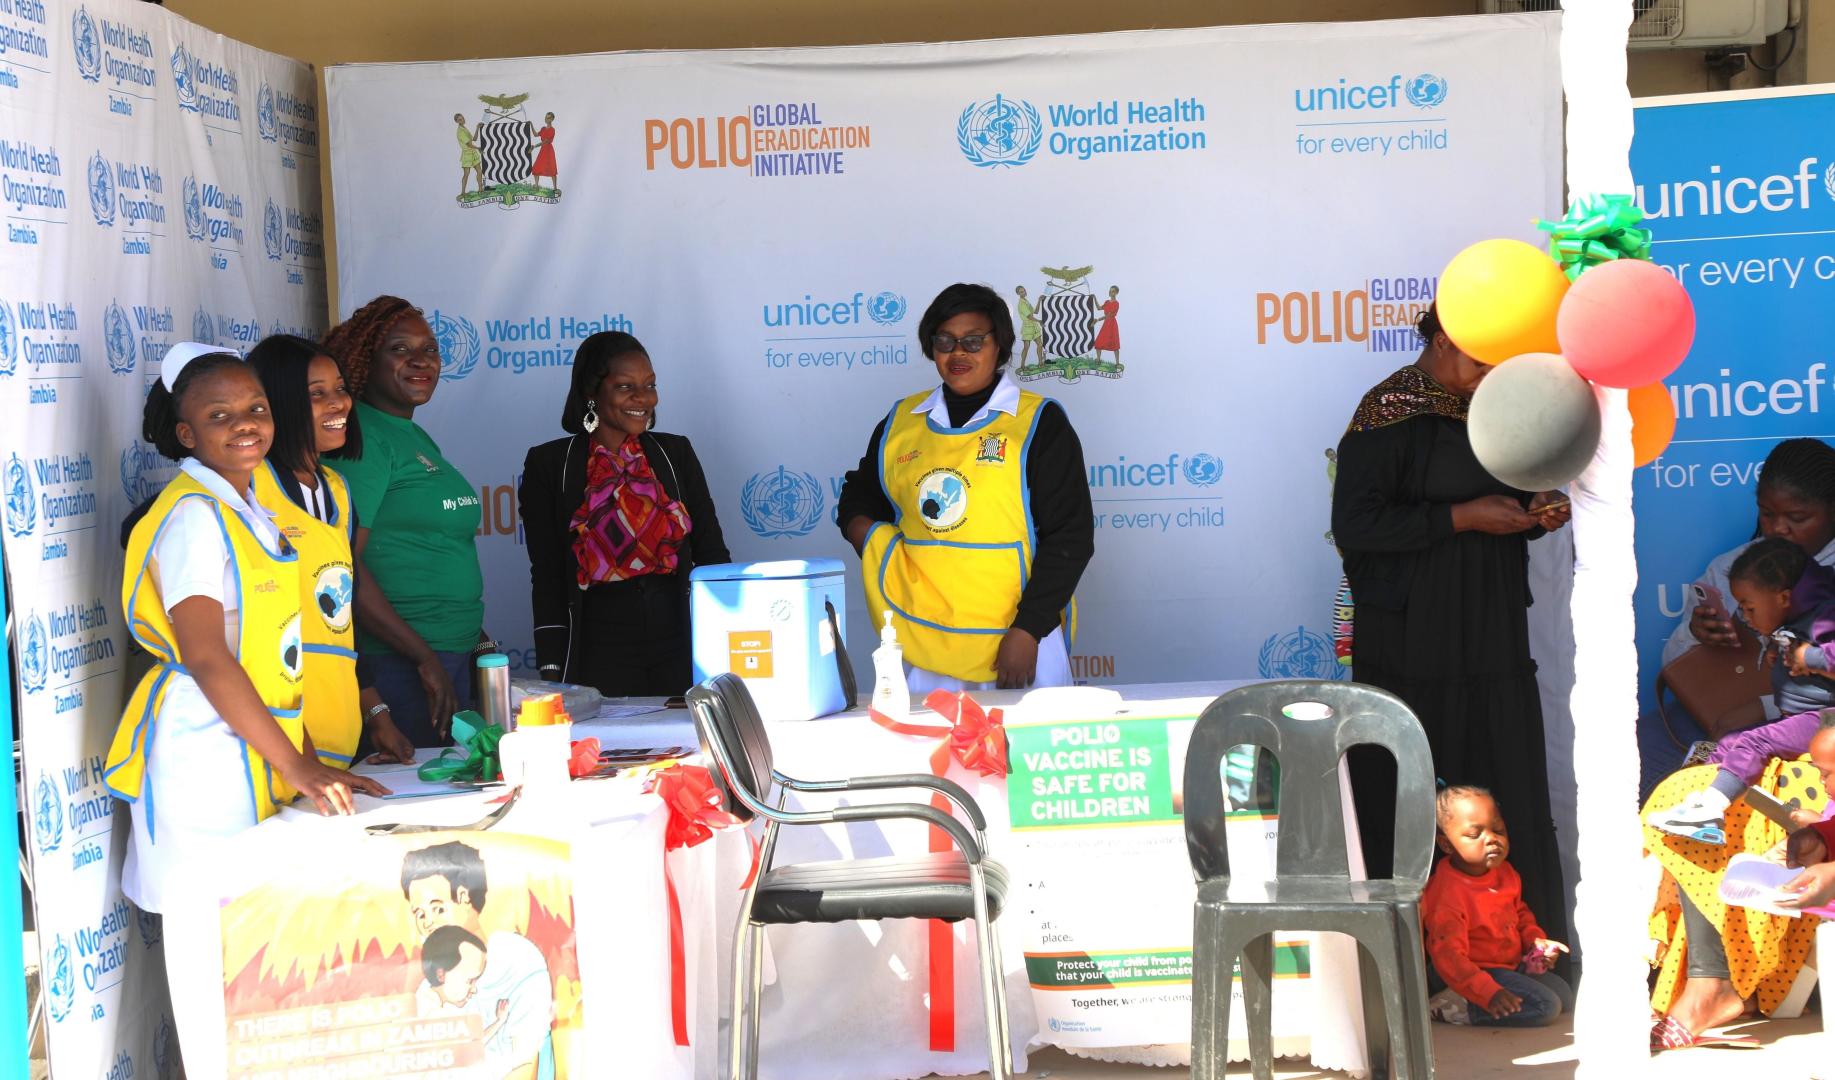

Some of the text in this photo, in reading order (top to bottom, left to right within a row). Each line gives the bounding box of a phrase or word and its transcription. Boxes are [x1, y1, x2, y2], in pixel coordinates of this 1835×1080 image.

[0, 22, 48, 58] ganization
[0, 66, 18, 88] mbia
[1295, 75, 1401, 112] unicef
[753, 103, 822, 127] GLOBAL
[1048, 97, 1206, 128] World Health
[645, 115, 750, 170] POLIO
[754, 126, 870, 152] ERADICATION
[1048, 126, 1207, 160] Organization
[1296, 129, 1448, 156] for every child
[0, 139, 61, 177] World Health
[755, 152, 844, 176] INITIATIVE
[1635, 157, 1818, 220] unicef
[8, 223, 37, 245] Zambia
[1699, 256, 1805, 289] every
[763, 292, 864, 327] unicef
[1256, 289, 1369, 345] POLIO
[485, 316, 552, 342] World
[487, 343, 575, 374] Organiz
[765, 344, 908, 371] for every child
[61, 451, 93, 482] Health
[944, 467, 963, 477] multiple
[1650, 456, 1701, 488] for
[442, 499, 457, 511] My
[457, 496, 472, 507] Child
[1111, 512, 1171, 533] every
[1176, 506, 1225, 528] child
[48, 604, 77, 639] World
[51, 632, 116, 679] Organization
[54, 688, 84, 714] Zambia
[1050, 723, 1120, 746] POLIO
[1023, 747, 1152, 772] VACCINE IS
[1031, 771, 1146, 796] SAFE FOR
[1031, 795, 1150, 820] CHILDREN
[1056, 960, 1095, 970] Protect
[1096, 960, 1121, 971] your
[1123, 956, 1149, 967] child
[1150, 955, 1177, 966] from
[1056, 971, 1078, 981] that
[1080, 971, 1105, 983] your
[1105, 967, 1132, 979] child
[1133, 967, 1143, 977] is
[1071, 997, 1119, 1010] Together,
